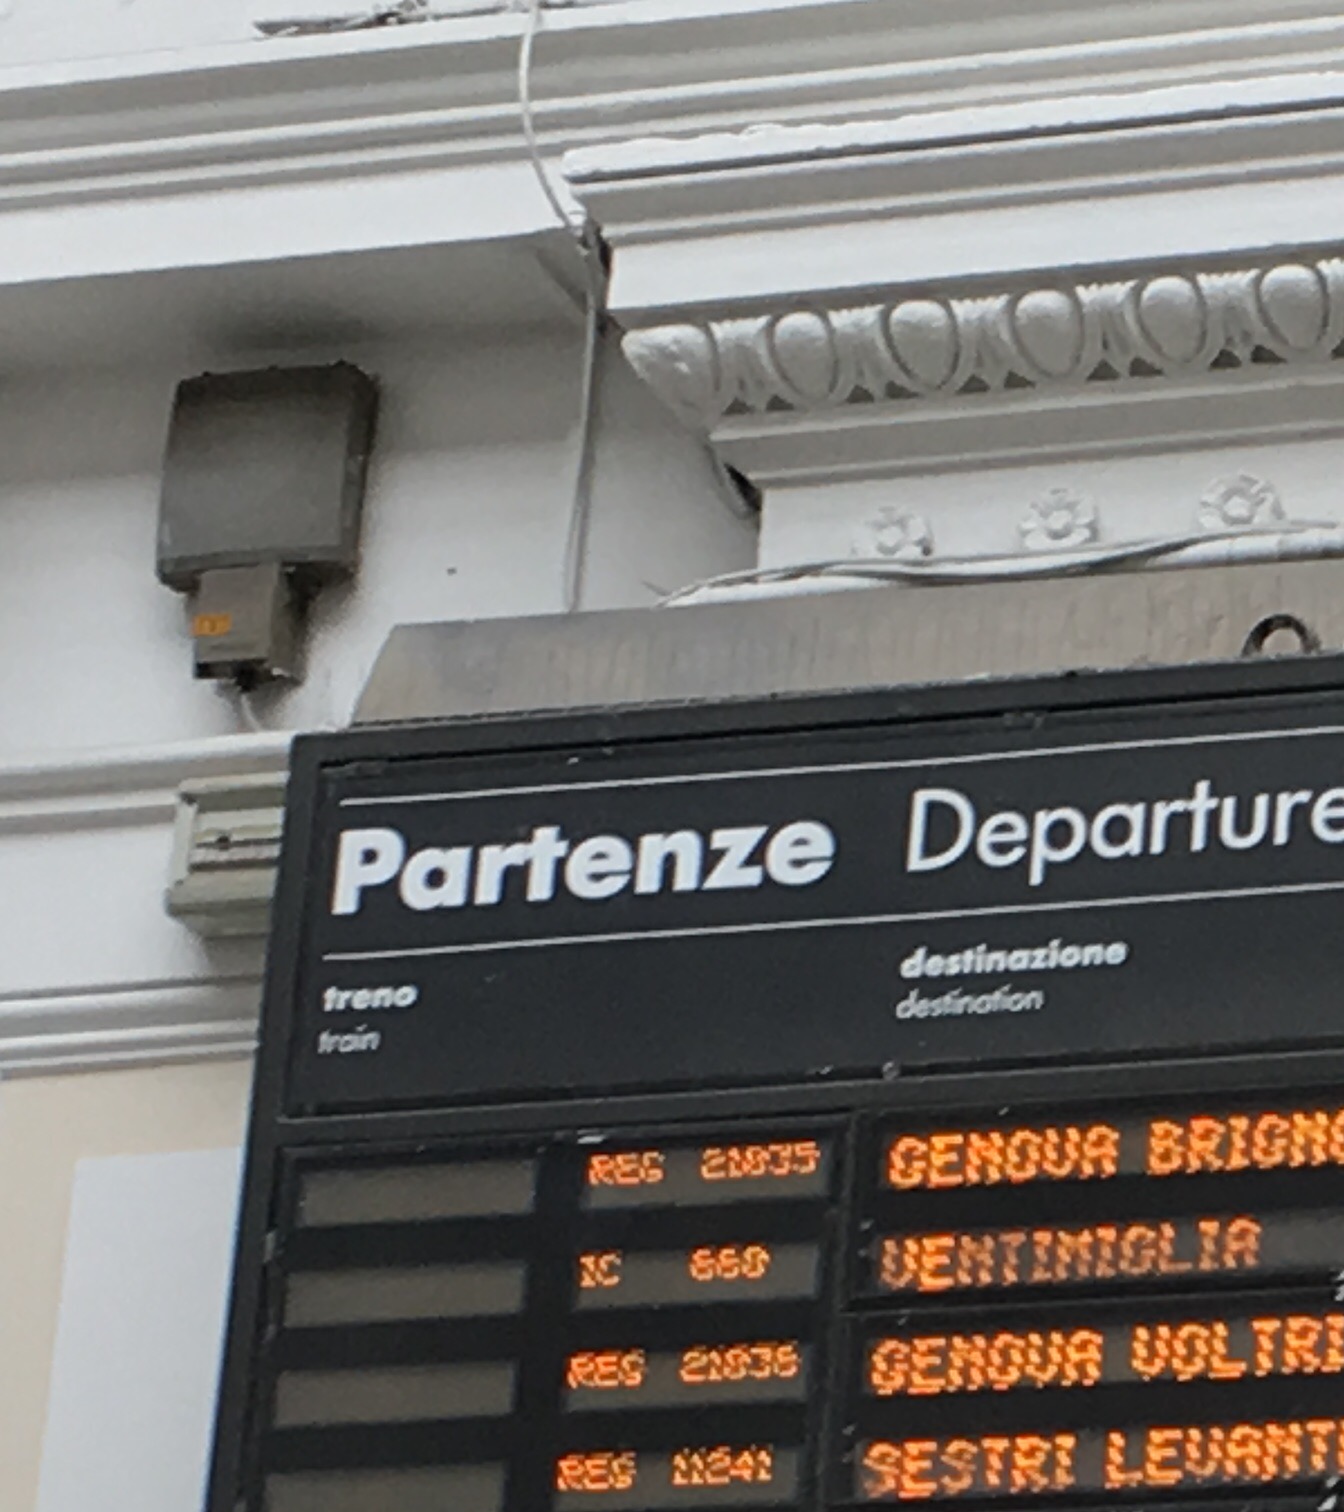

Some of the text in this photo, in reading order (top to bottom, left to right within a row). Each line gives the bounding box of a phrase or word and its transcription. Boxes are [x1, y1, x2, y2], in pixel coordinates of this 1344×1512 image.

[331, 820, 836, 915] Partenze
[900, 939, 1127, 978] destinazione
[323, 985, 417, 1012] treno
[895, 984, 1044, 1019] destination
[318, 1024, 380, 1053] train
[588, 1151, 665, 1186] REG
[888, 1124, 1121, 1189] GENOVA
[579, 1253, 621, 1288] IC
[881, 1217, 1263, 1292] VENTIMIGLIA
[566, 1350, 646, 1389] REG
[870, 1328, 1104, 1396] GENOVA
[556, 1452, 637, 1493] REG
[862, 1433, 1077, 1500] SESTRI
